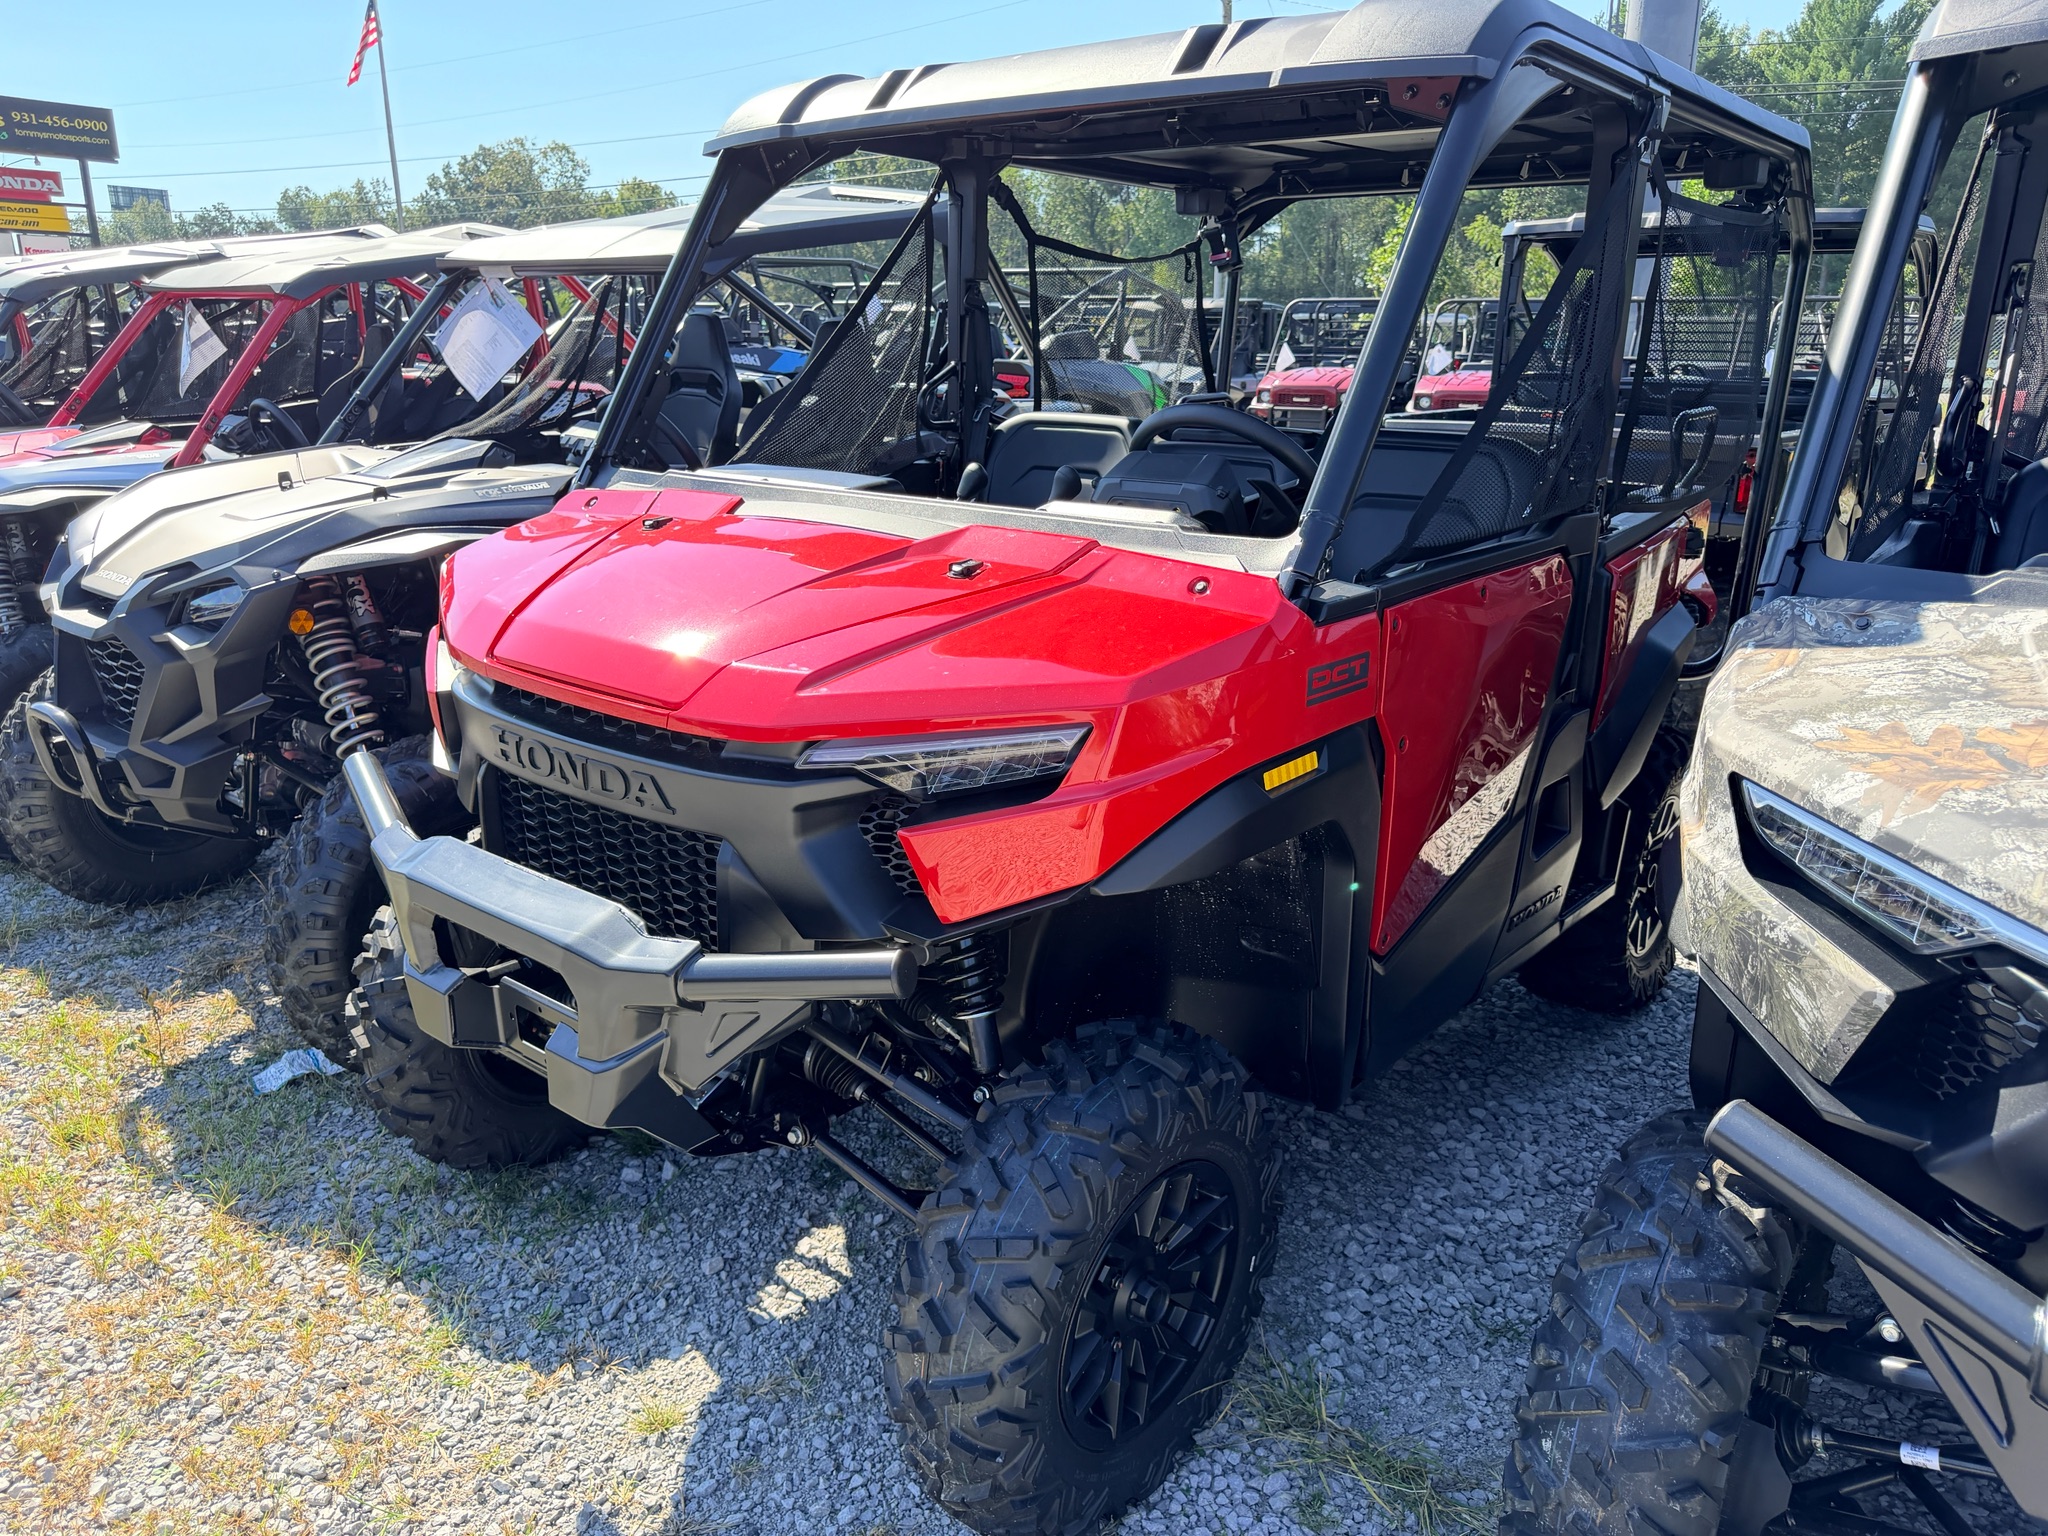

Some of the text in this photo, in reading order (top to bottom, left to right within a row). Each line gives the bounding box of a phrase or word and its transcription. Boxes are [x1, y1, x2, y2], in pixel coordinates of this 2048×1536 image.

[11, 111, 108, 132] 931-456-0900
[15, 128, 110, 145] tommysmotorsports.com
[0, 175, 63, 192] NDA
[96, 569, 133, 585] HONDA
[346, 574, 375, 616] FOX
[1312, 657, 1366, 689] DCT
[490, 724, 676, 815] HONDA
[1506, 884, 1563, 933] HONDA
